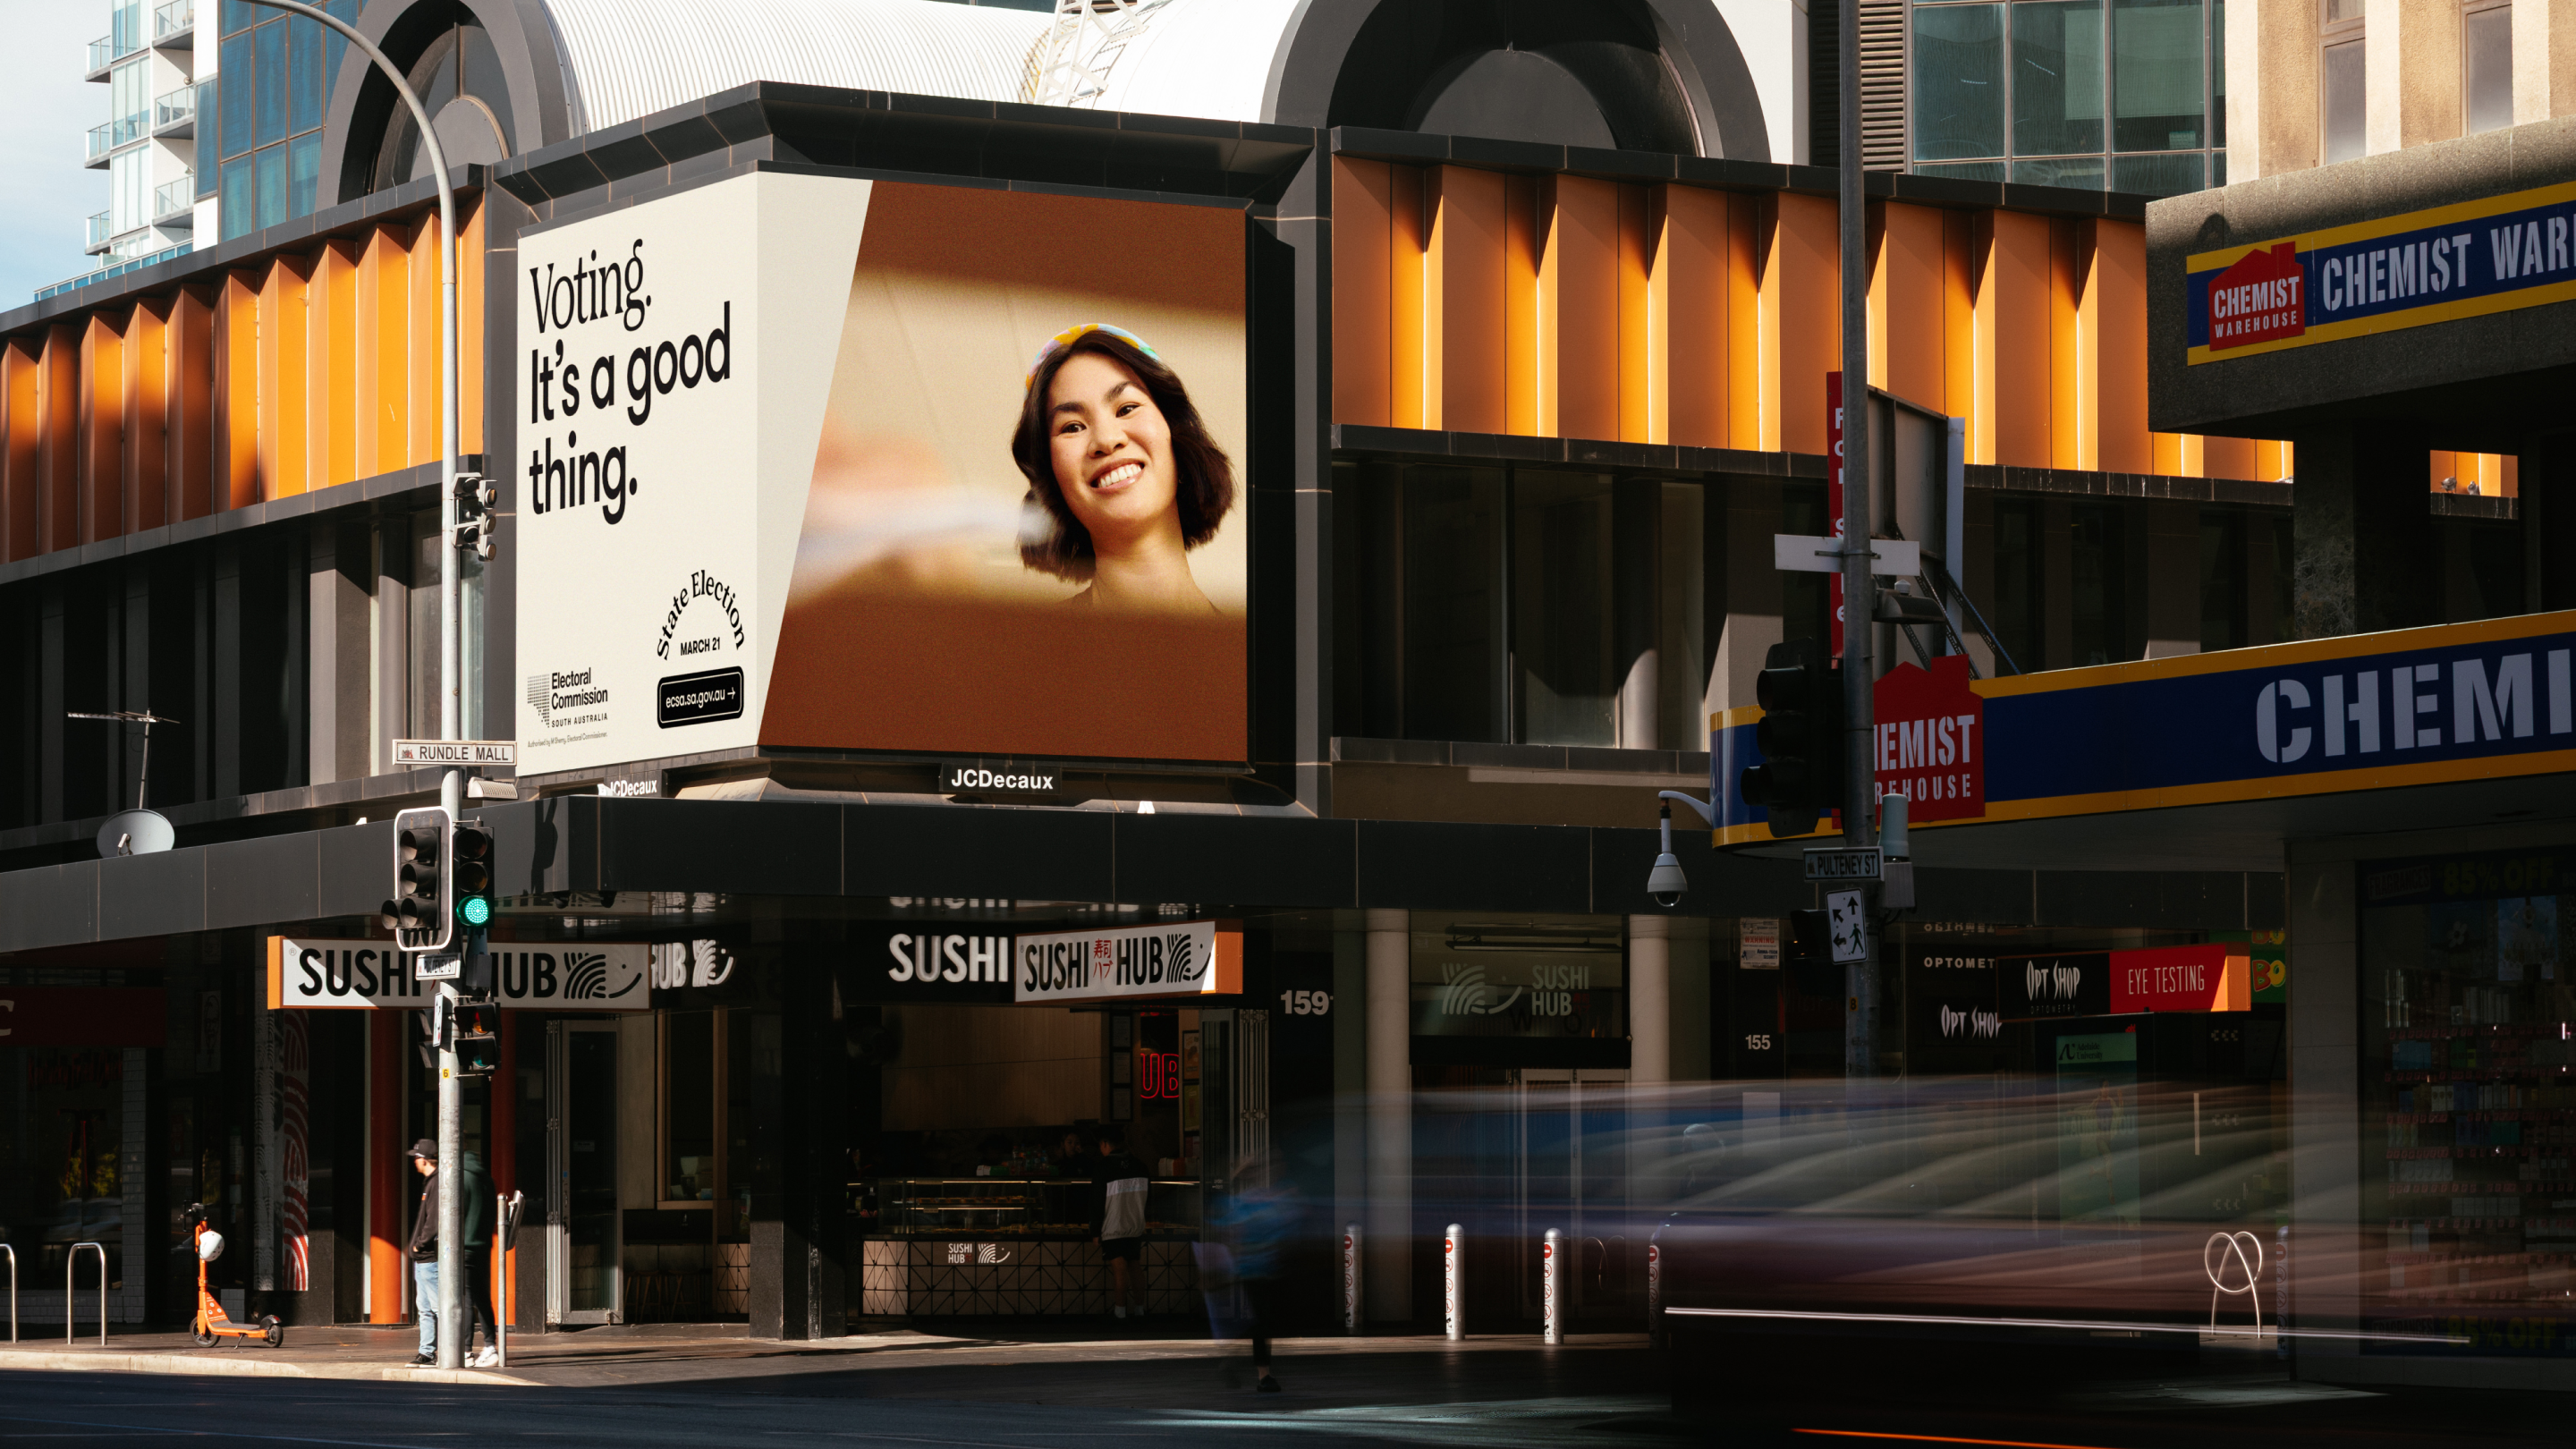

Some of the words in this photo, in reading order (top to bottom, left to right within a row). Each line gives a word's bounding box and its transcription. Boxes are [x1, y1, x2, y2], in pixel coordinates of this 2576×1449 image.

[2323, 233, 2472, 311] CHEMIST
[529, 238, 652, 334] Voting.
[2214, 275, 2300, 319] CHEMIST
[2215, 309, 2298, 339] WAREHOUSE
[530, 338, 580, 425] It's
[590, 354, 615, 409] a
[627, 300, 732, 427] good
[529, 429, 638, 526] thing.
[657, 588, 690, 661] State
[691, 569, 745, 651] Election
[680, 638, 710, 656] MARCH
[712, 636, 721, 650] 21
[551, 666, 591, 690] Electoral
[551, 686, 608, 710] Commission
[665, 688, 726, 708] ecsa.sa.gov.au
[2256, 648, 2572, 763] CHEMI
[551, 718, 572, 728] SOUTH
[573, 712, 608, 724] AUSTRALIA
[419, 746, 469, 760] RUNDLE
[476, 747, 509, 761] MALL
[951, 768, 1054, 790] JCDecaux
[1818, 854, 1862, 876] PULTENEY
[1865, 854, 1876, 875] ST
[887, 932, 1010, 983] SUSHI
[1023, 940, 1089, 993] SUSHI
[1115, 936, 1164, 986] HUB
[298, 948, 421, 997] SUSHI
[1531, 964, 1589, 990] SUSHI
[2128, 968, 2148, 995] EYE
[2154, 964, 2205, 994] TESTING
[1531, 991, 1572, 1017] HUB
[1850, 998, 1857, 1010] 8
[1745, 1034, 1771, 1050] 155
[444, 1069, 449, 1078] 6
[948, 1242, 972, 1253] SUSHI
[948, 1253, 965, 1264] HUB
